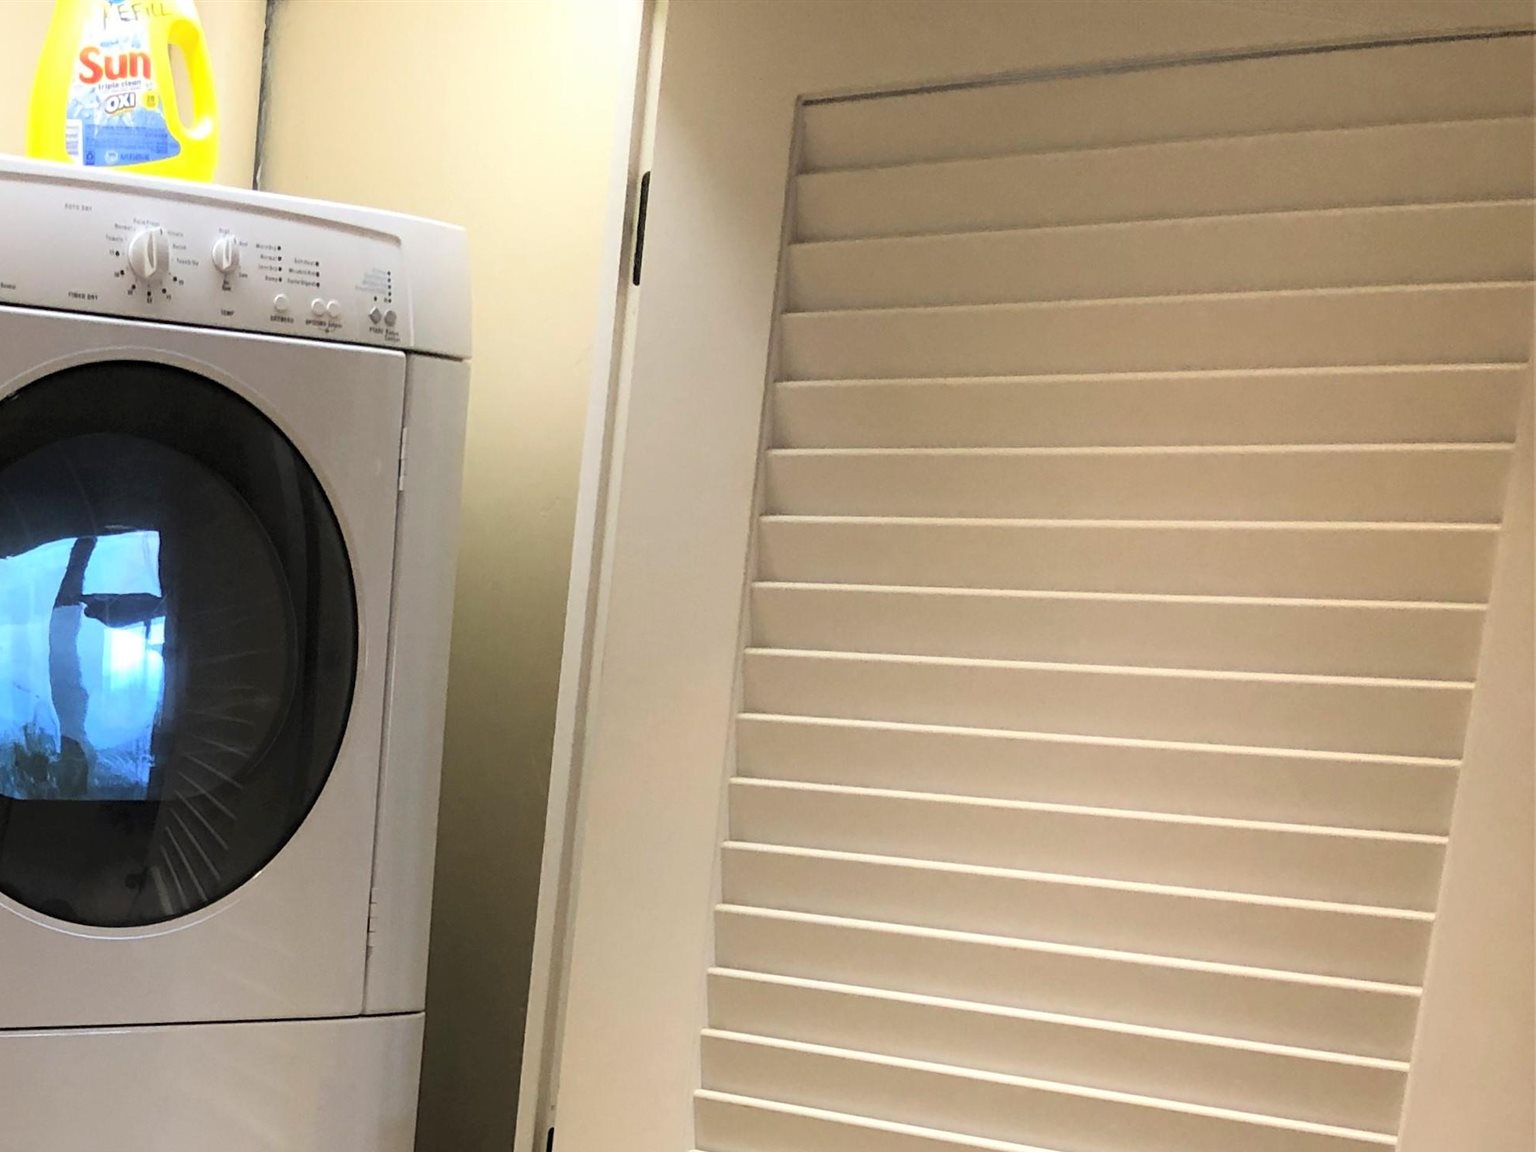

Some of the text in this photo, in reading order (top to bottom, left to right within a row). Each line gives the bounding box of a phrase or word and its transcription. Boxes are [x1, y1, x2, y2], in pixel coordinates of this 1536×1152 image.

[79, 46, 151, 84] Sun
[98, 80, 142, 91] triple clean
[104, 92, 136, 114] OXI
